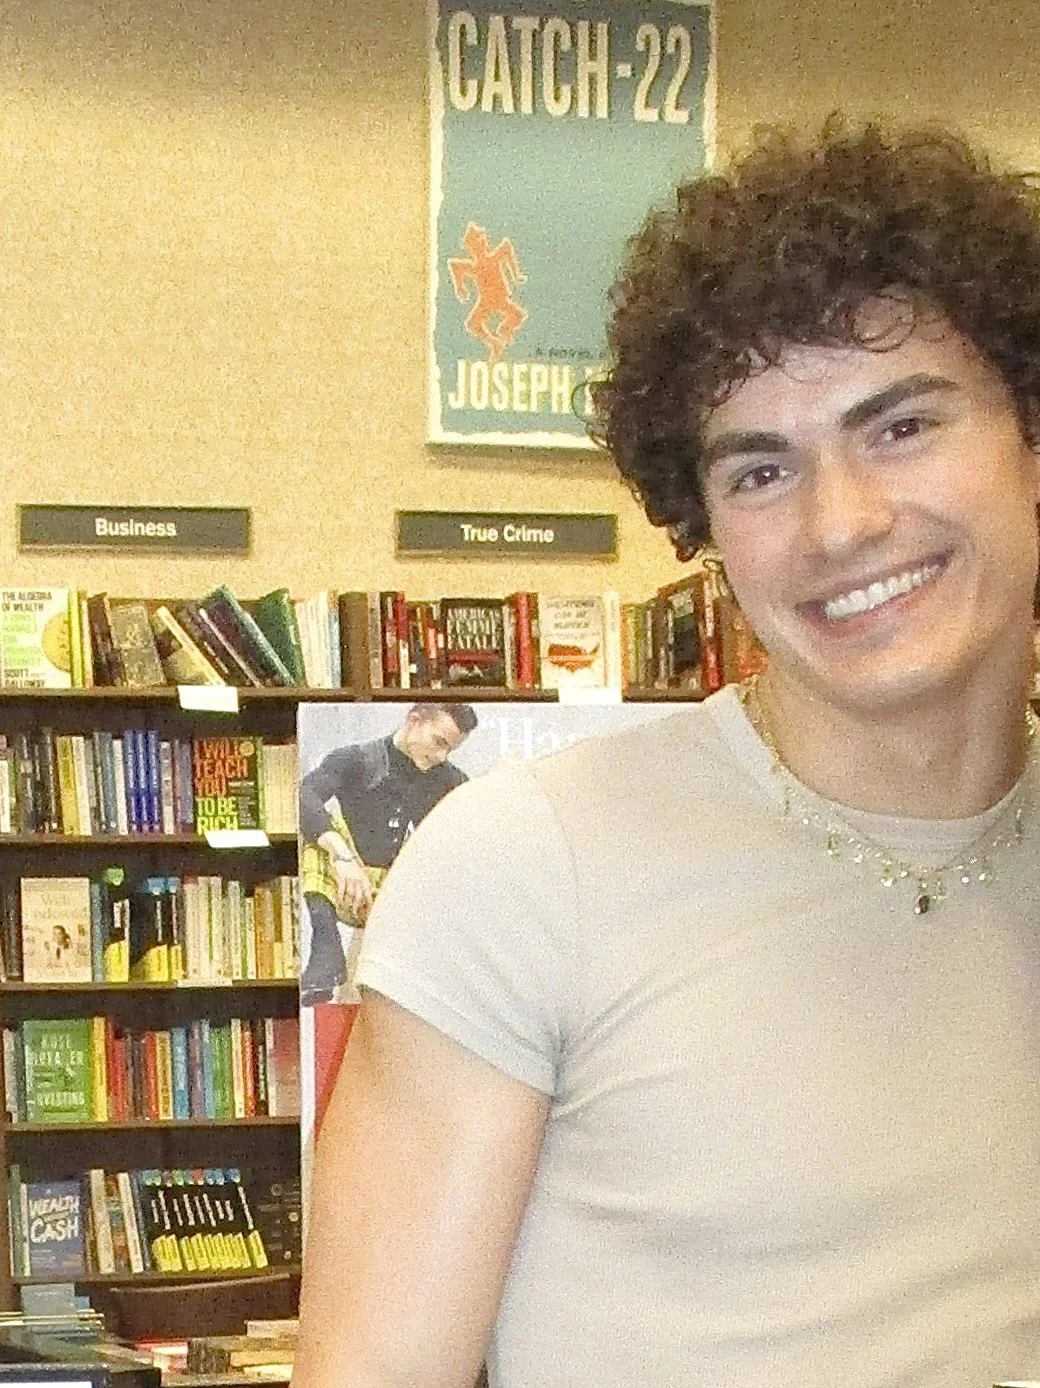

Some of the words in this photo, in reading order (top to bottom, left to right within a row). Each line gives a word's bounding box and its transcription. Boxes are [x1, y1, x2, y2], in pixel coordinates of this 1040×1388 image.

[449, 11, 692, 124] CATCH-22
[448, 358, 575, 415] JOSEPH
[94, 517, 177, 537] Business
[460, 524, 499, 542] True
[503, 523, 555, 543] Crime
[194, 757, 249, 778] TEACH
[195, 797, 216, 816] TO
[217, 796, 238, 816] BE
[196, 815, 239, 835] RICH
[30, 1216, 79, 1243] CASH
